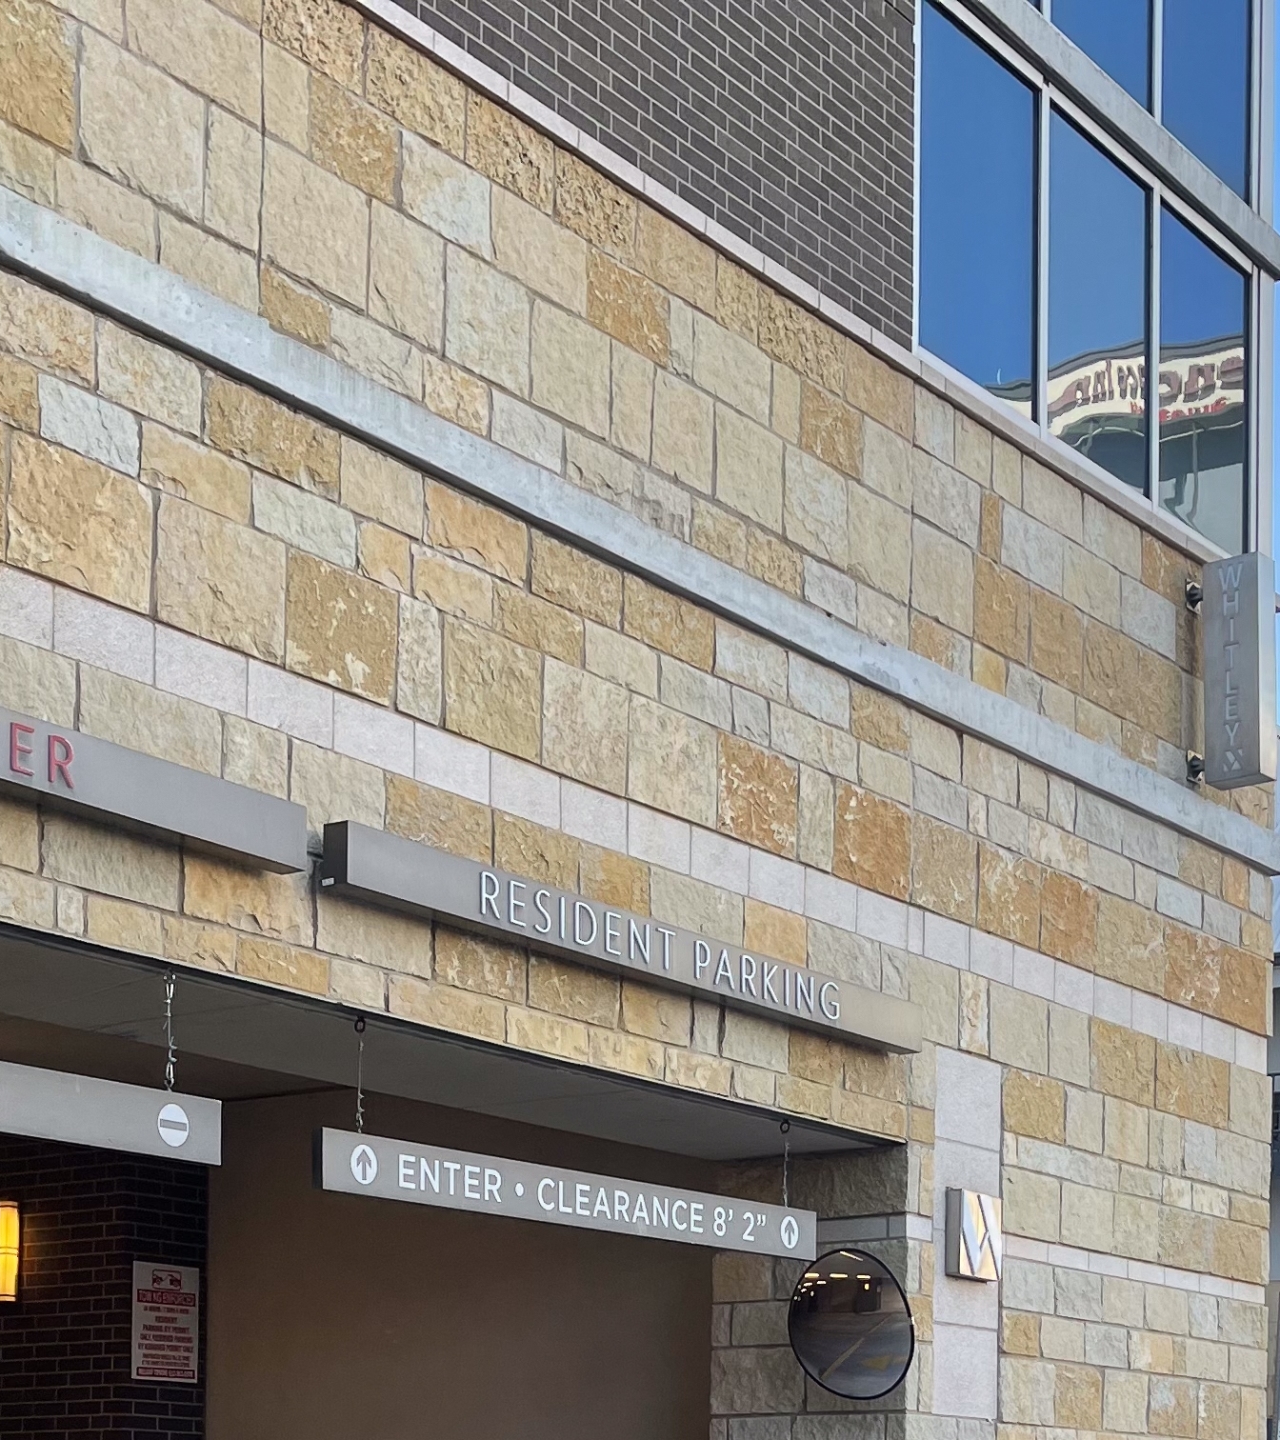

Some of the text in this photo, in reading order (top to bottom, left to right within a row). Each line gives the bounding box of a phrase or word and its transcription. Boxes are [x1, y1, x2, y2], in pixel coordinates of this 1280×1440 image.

[1218, 562, 1244, 748] WHITLEY
[479, 870, 841, 1020] RESIDENT PARKING
[398, 1153, 502, 1203] ENTER
[536, 1177, 705, 1235] CLEARANCE
